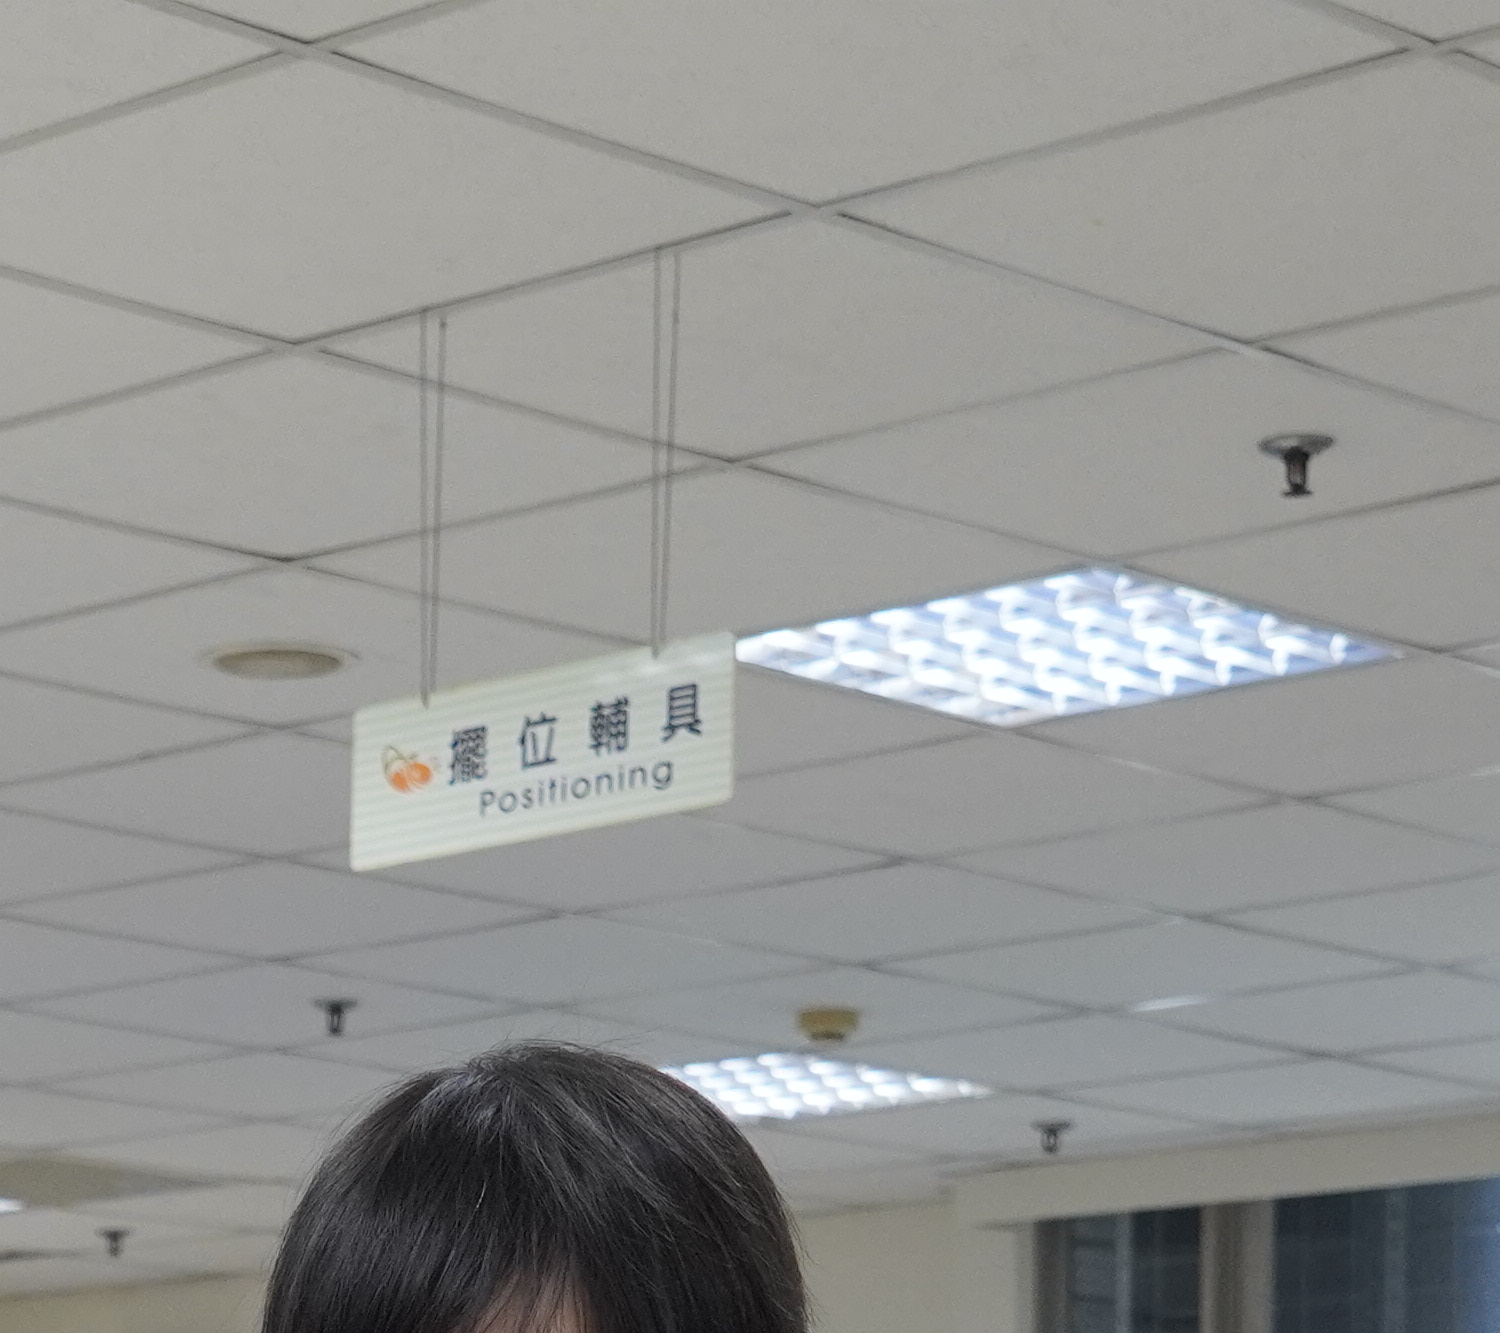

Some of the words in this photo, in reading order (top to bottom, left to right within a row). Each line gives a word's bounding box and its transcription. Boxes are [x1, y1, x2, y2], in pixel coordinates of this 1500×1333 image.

[448, 682, 702, 786] 擺位輔具
[480, 760, 674, 816] Positioning
